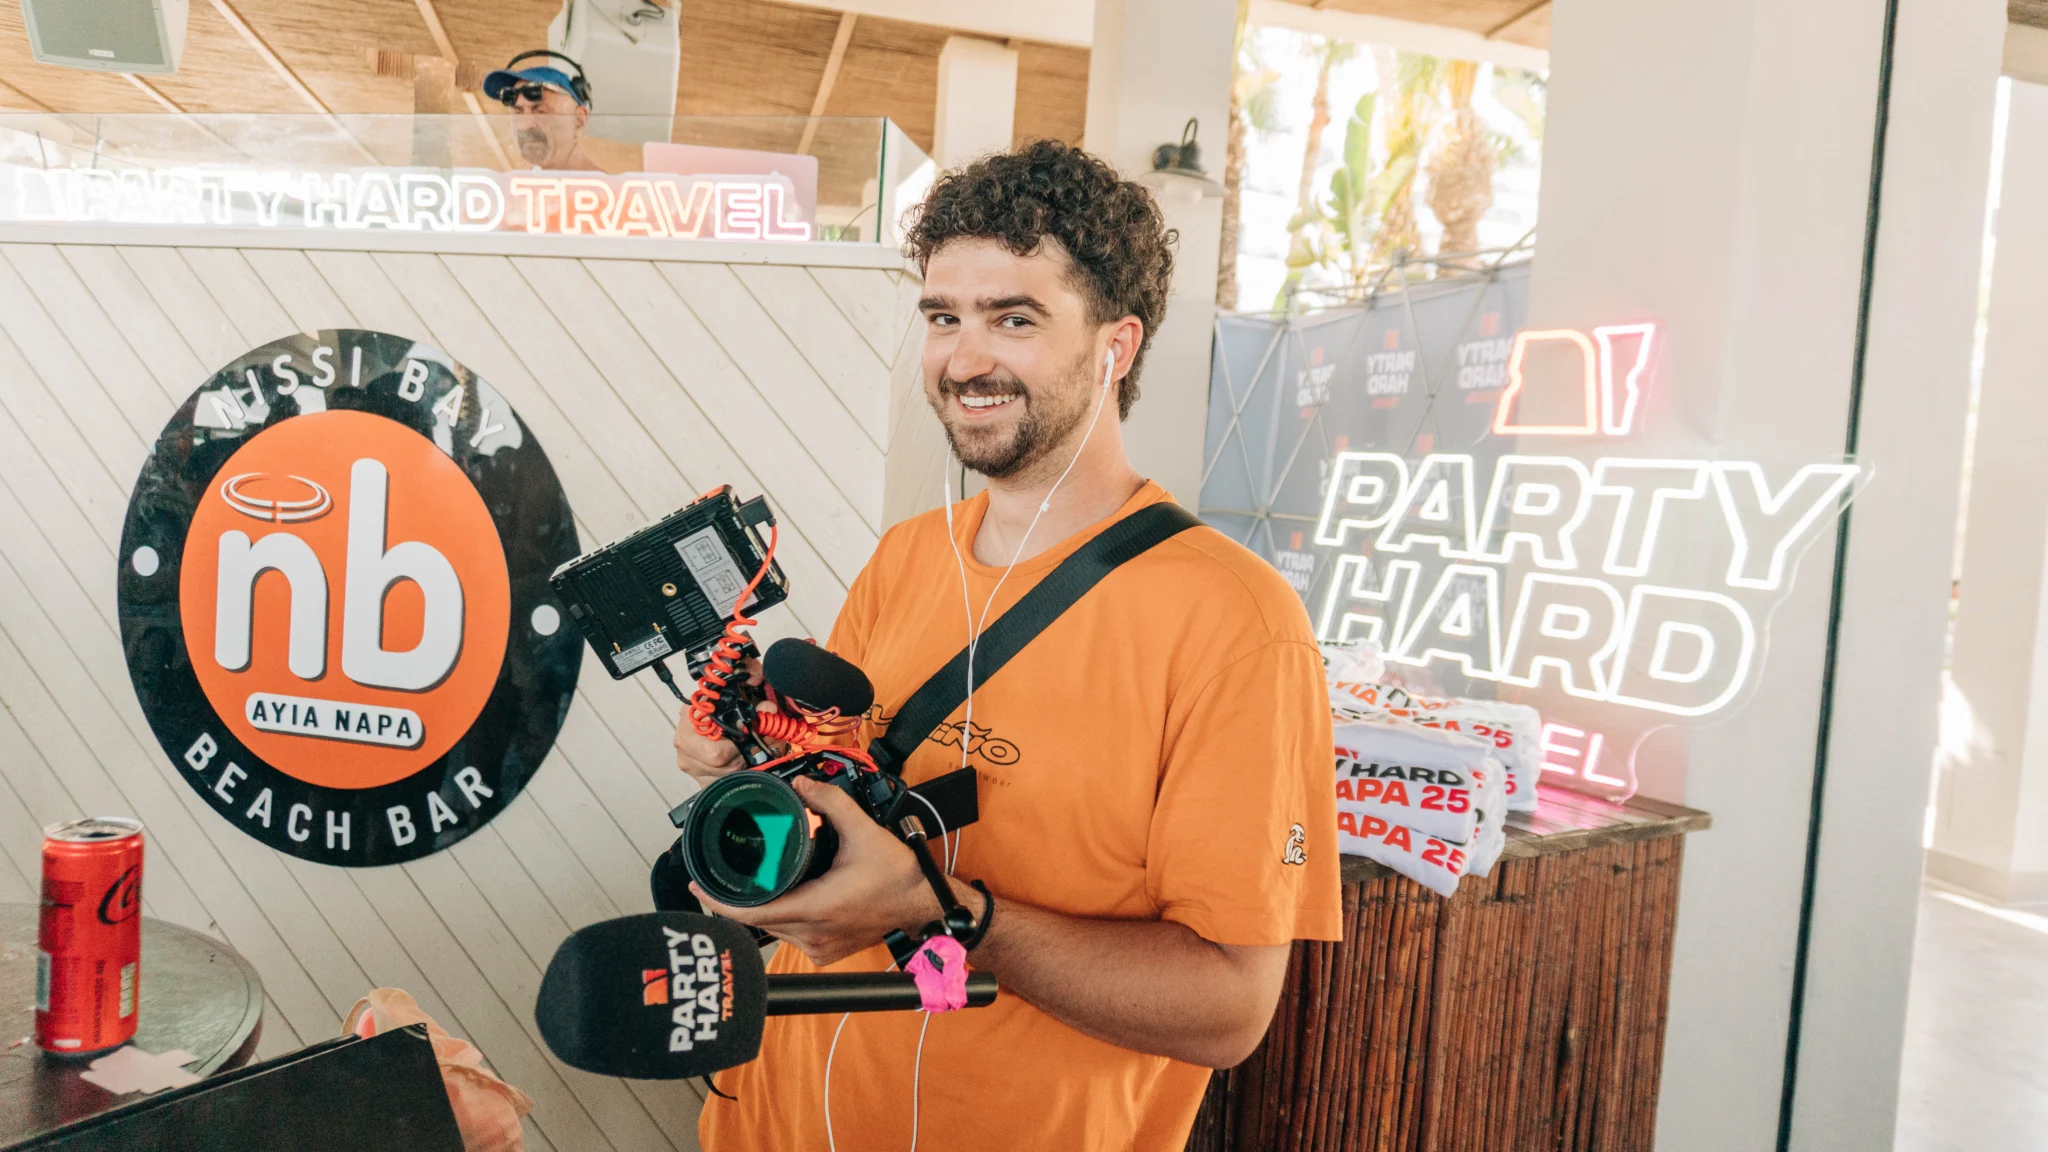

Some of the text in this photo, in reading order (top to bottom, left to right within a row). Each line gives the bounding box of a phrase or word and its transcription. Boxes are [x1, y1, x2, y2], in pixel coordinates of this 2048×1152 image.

[76, 168, 811, 241] PARTY HARD TRAVEL
[210, 346, 505, 447] NISSI BAY
[1313, 451, 1861, 591] PARTY
[215, 458, 464, 690] nb
[1316, 554, 1756, 716] HARD
[252, 700, 412, 739] AYIA NAPA
[1539, 722, 1626, 788] EL
[184, 733, 495, 851] BEACH BAR
[1336, 778, 1471, 814] APA 25
[1350, 763, 1466, 787] HARD
[1337, 811, 1468, 876] APA 25
[662, 925, 697, 1052] PARTY
[691, 933, 721, 1041] HARD
[720, 949, 734, 1022] TRAVEL
